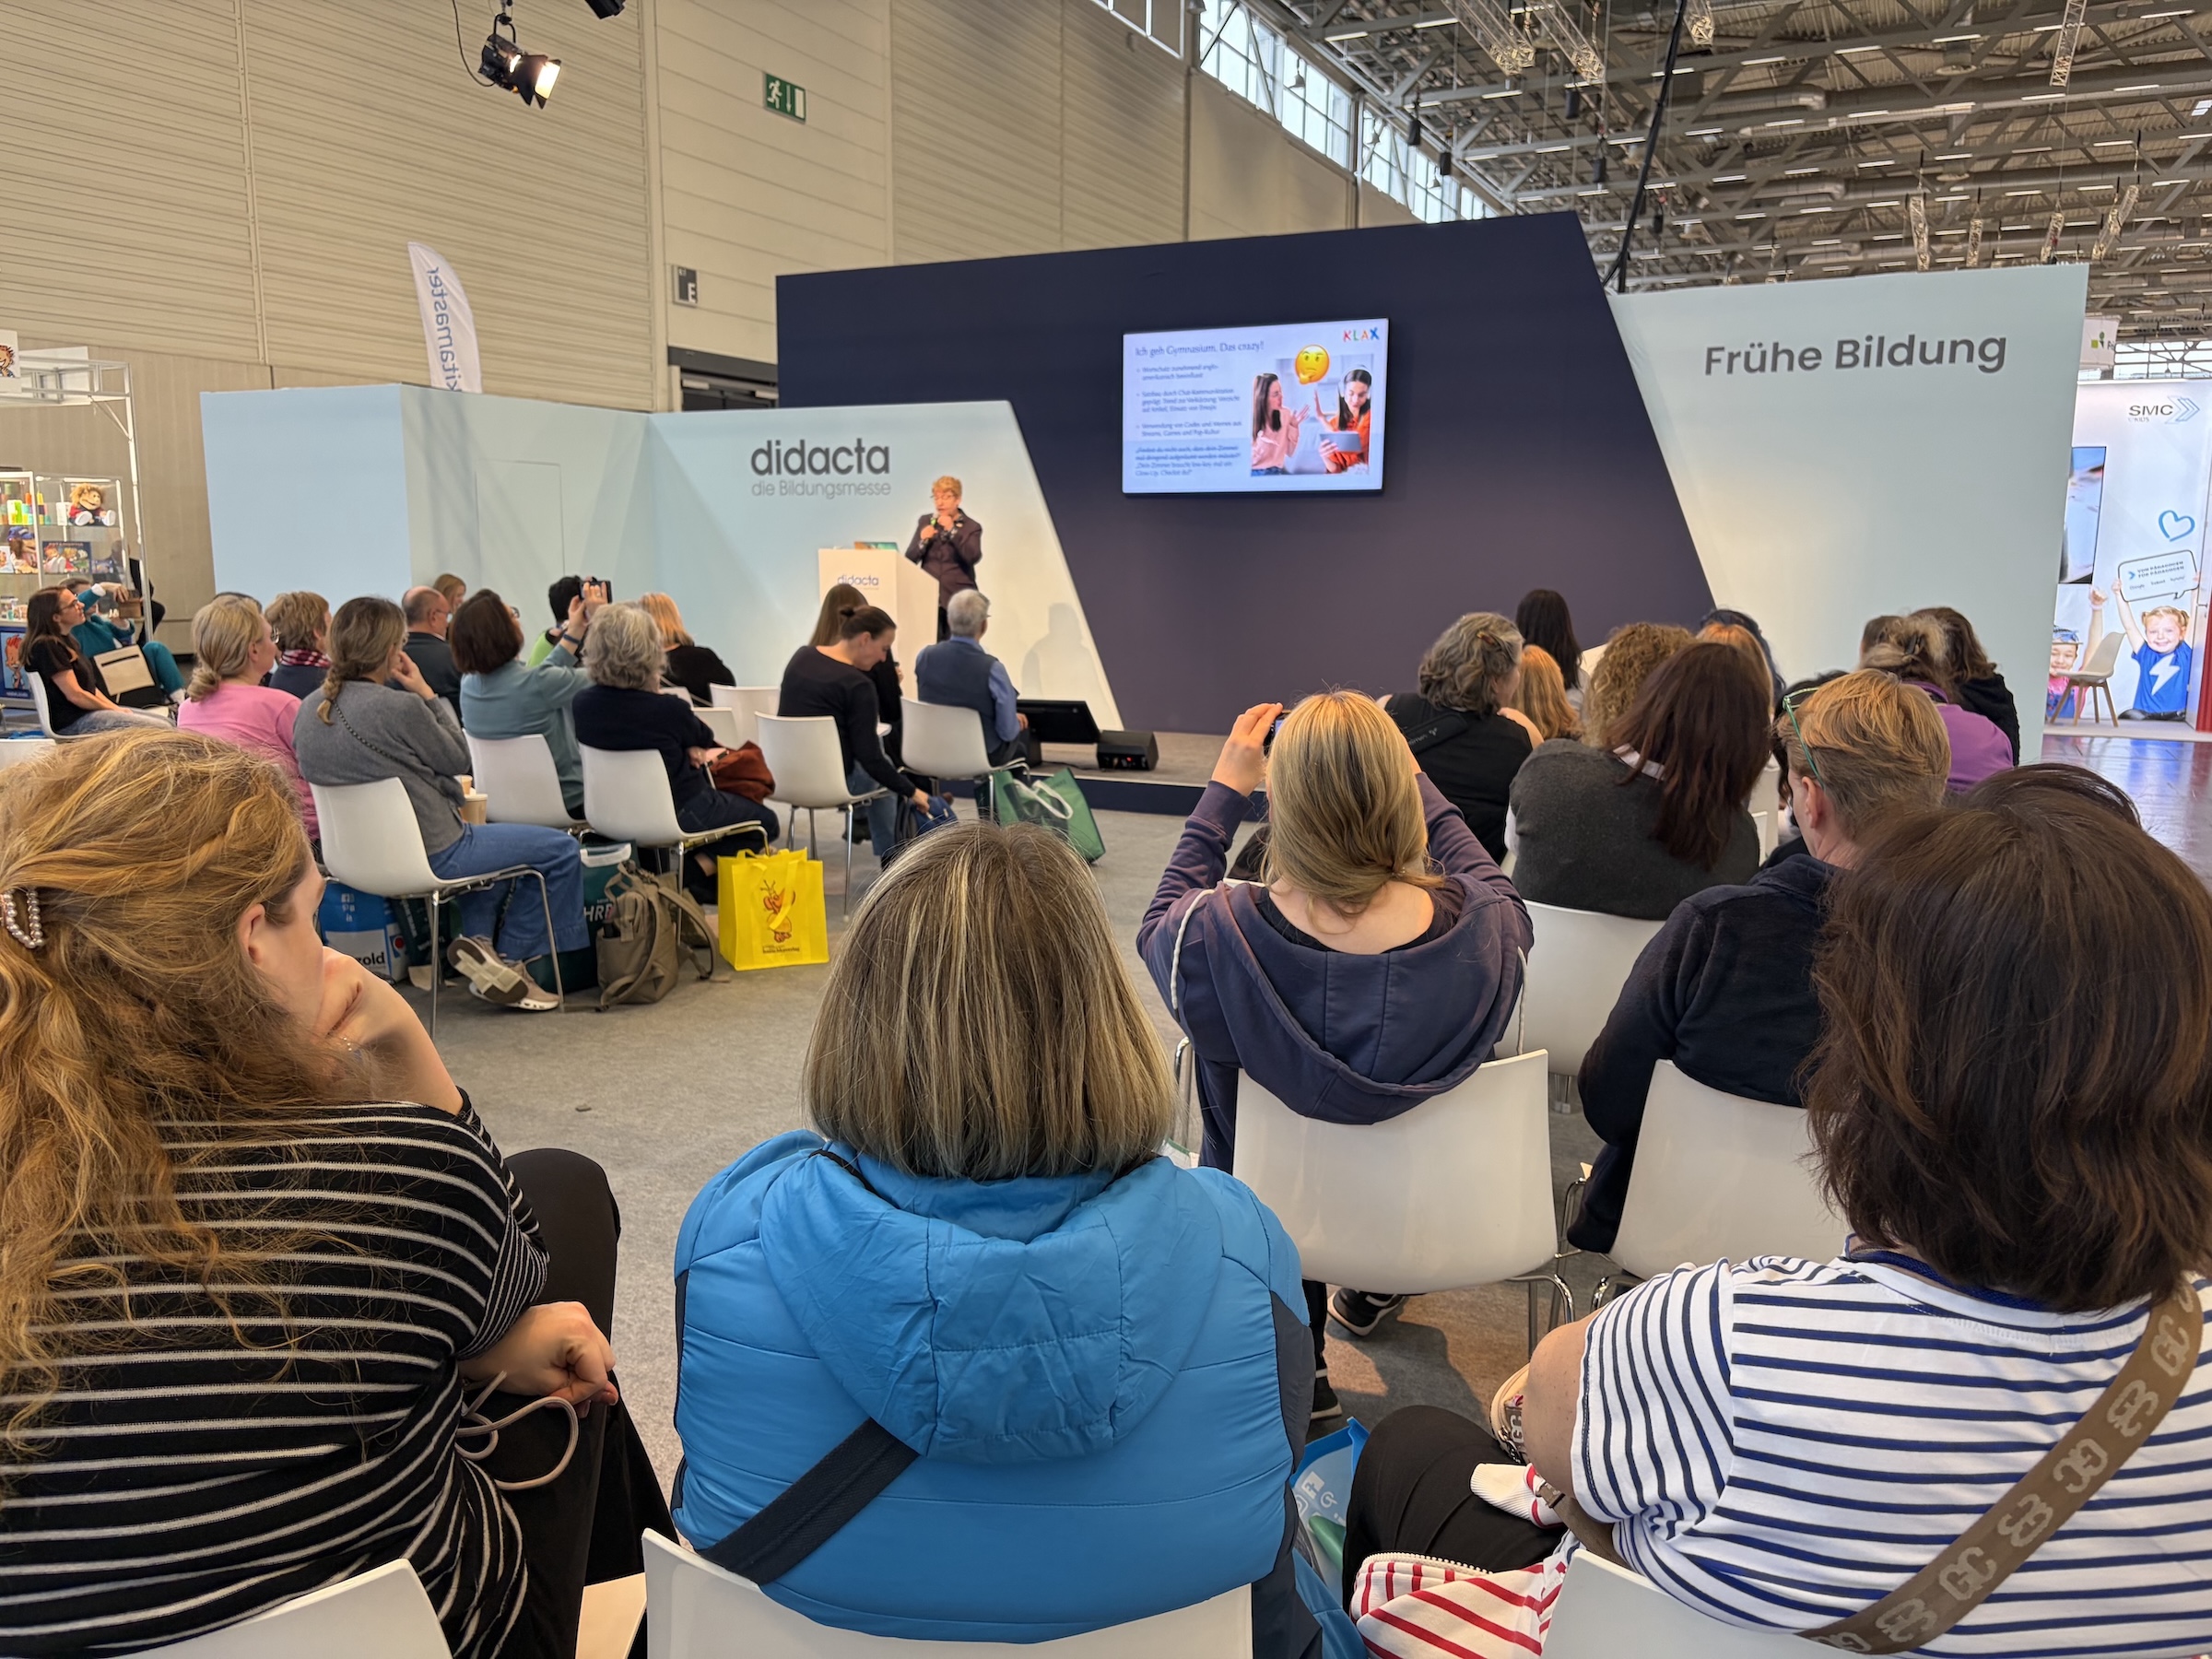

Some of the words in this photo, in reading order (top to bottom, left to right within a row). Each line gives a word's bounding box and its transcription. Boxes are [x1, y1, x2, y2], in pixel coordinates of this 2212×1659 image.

[688, 282, 696, 303] E
[1343, 328, 1380, 342] KLAX
[1219, 343, 1236, 352] Das
[1705, 341, 1822, 375] Frühe
[1835, 334, 2006, 373] Bildung
[2128, 405, 2173, 416] SMC
[751, 438, 890, 476] didacta
[751, 480, 775, 497] die
[779, 479, 891, 500] Bildungsmesse
[837, 574, 879, 586] didacta
